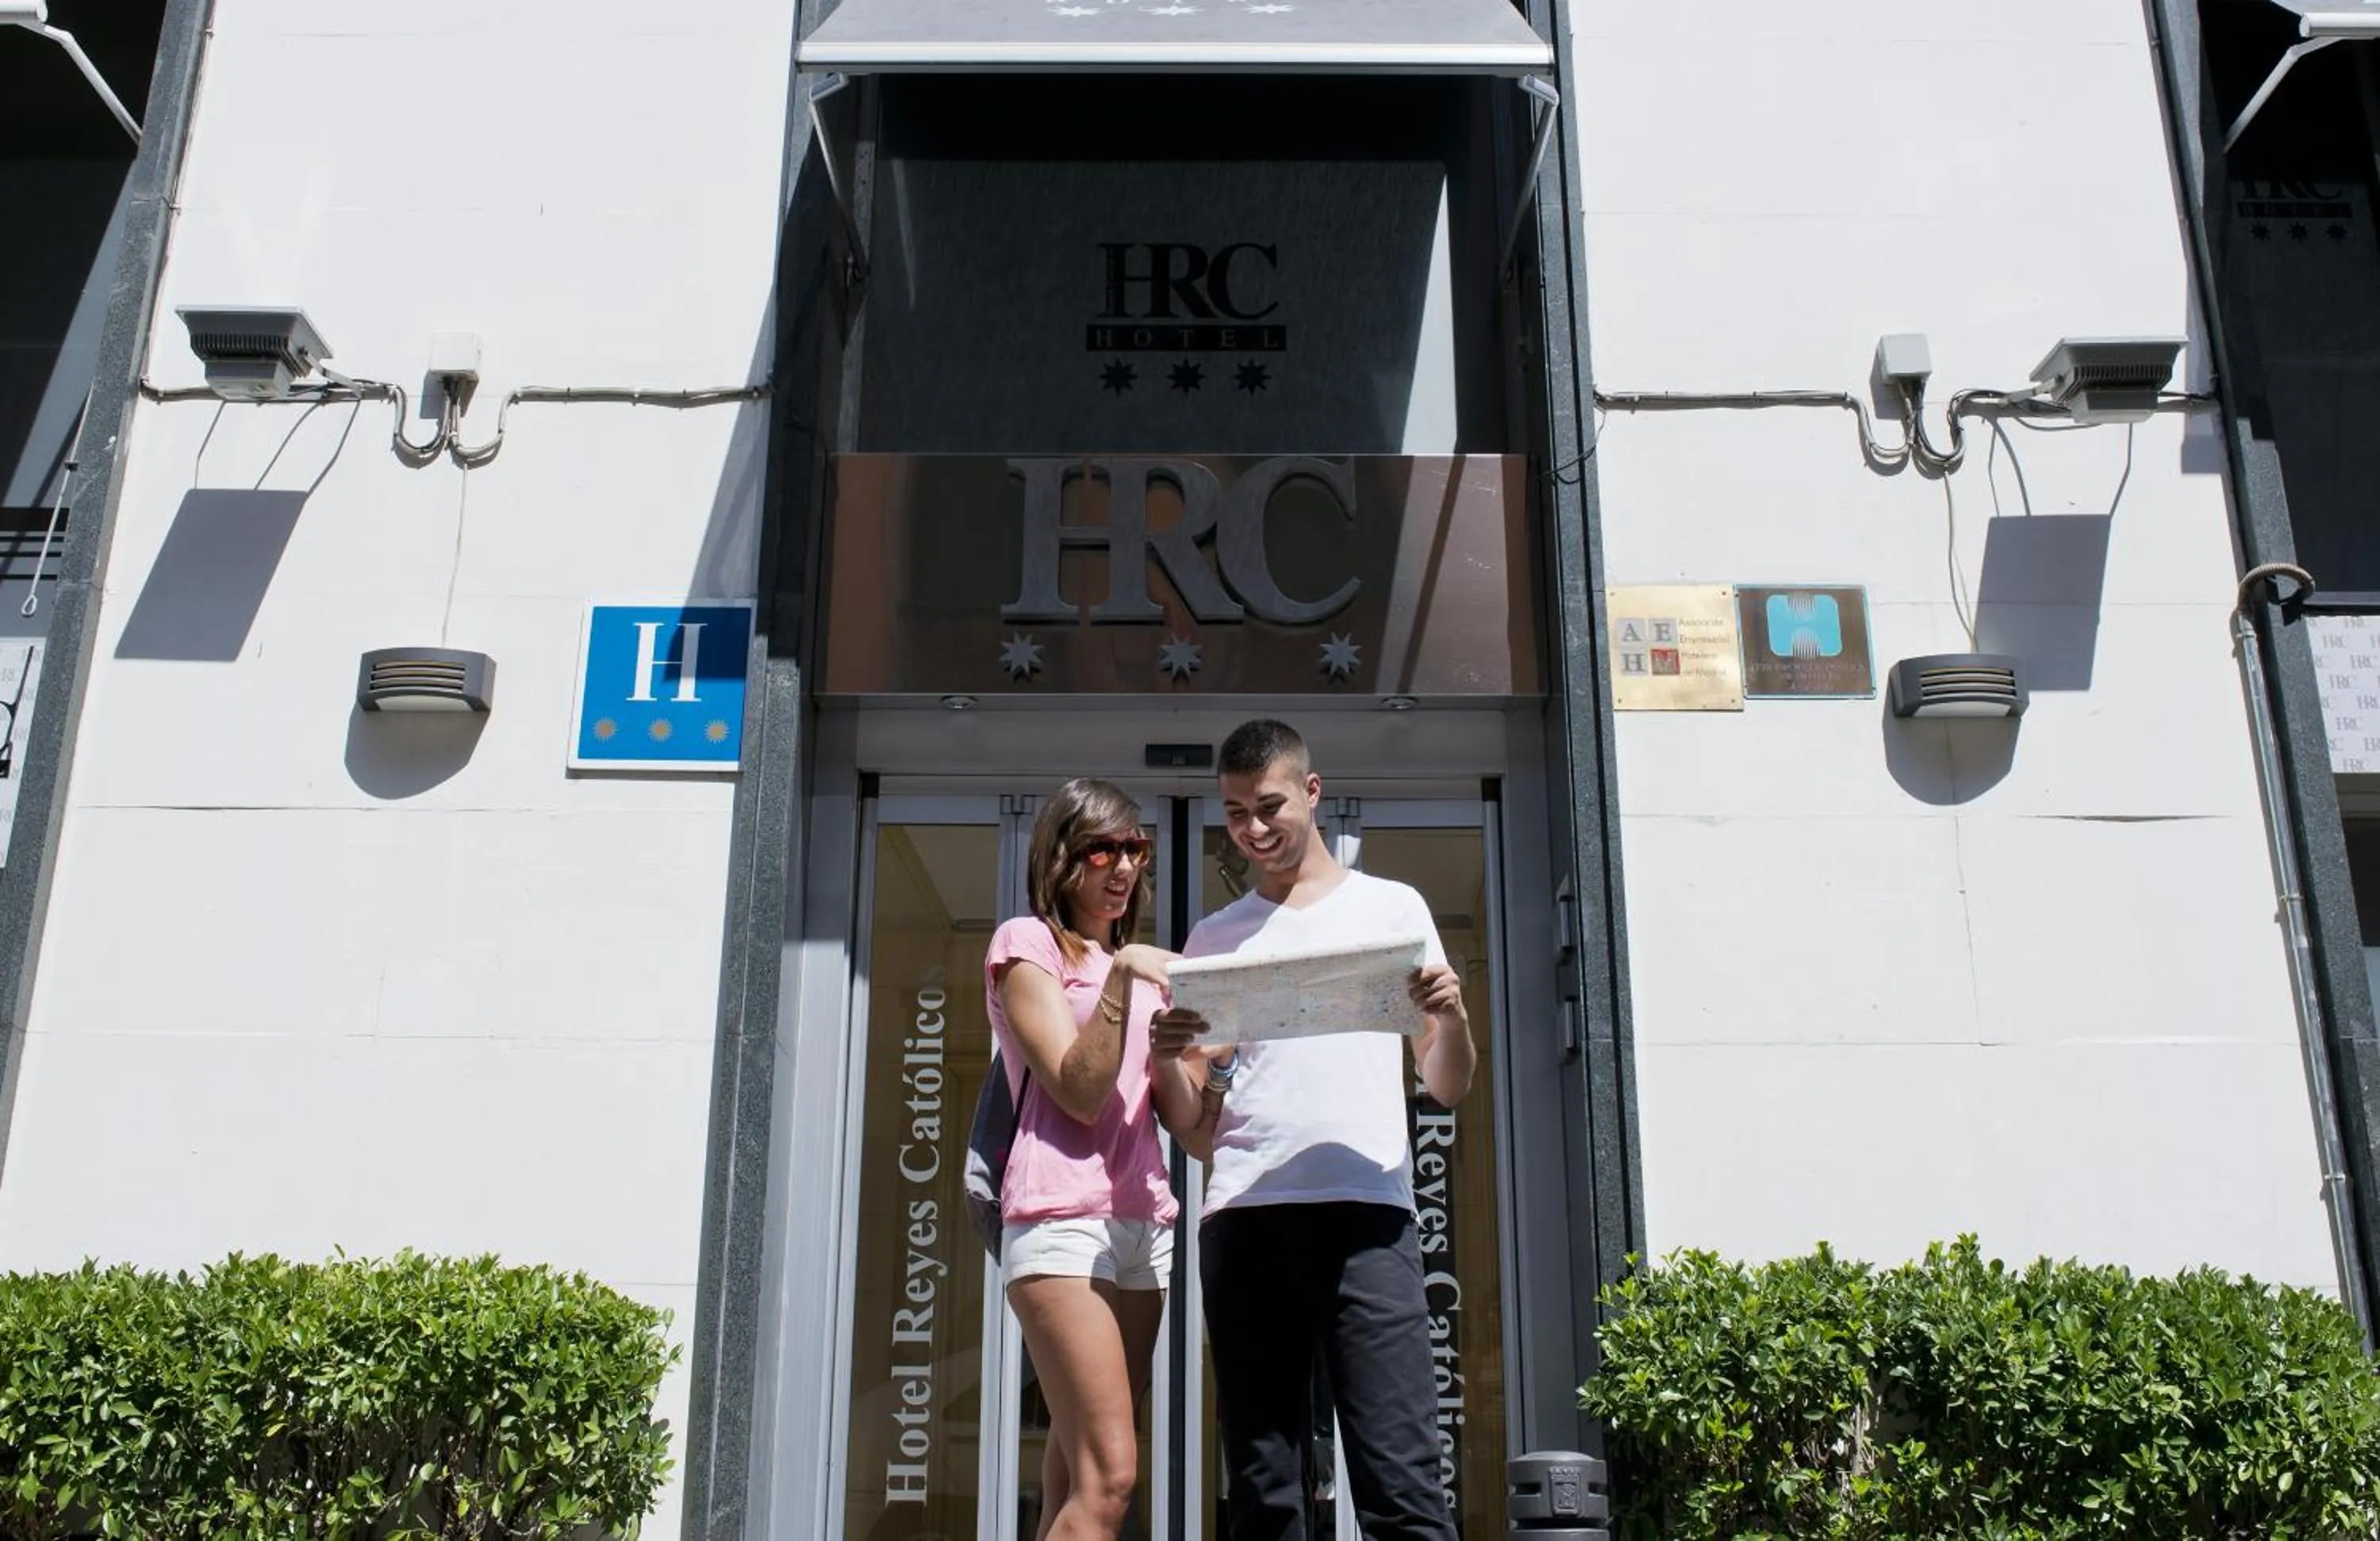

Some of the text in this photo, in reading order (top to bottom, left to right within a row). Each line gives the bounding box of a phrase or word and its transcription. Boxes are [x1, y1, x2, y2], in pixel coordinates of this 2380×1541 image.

[1095, 329, 1278, 348] HOTEL
[1096, 242, 1279, 321] HRC
[1000, 455, 1361, 627] HRC
[626, 622, 708, 702] H
[1414, 1109, 1457, 1254] Reyes
[892, 1200, 948, 1346] Reyes
[885, 1363, 932, 1506] Hotel
